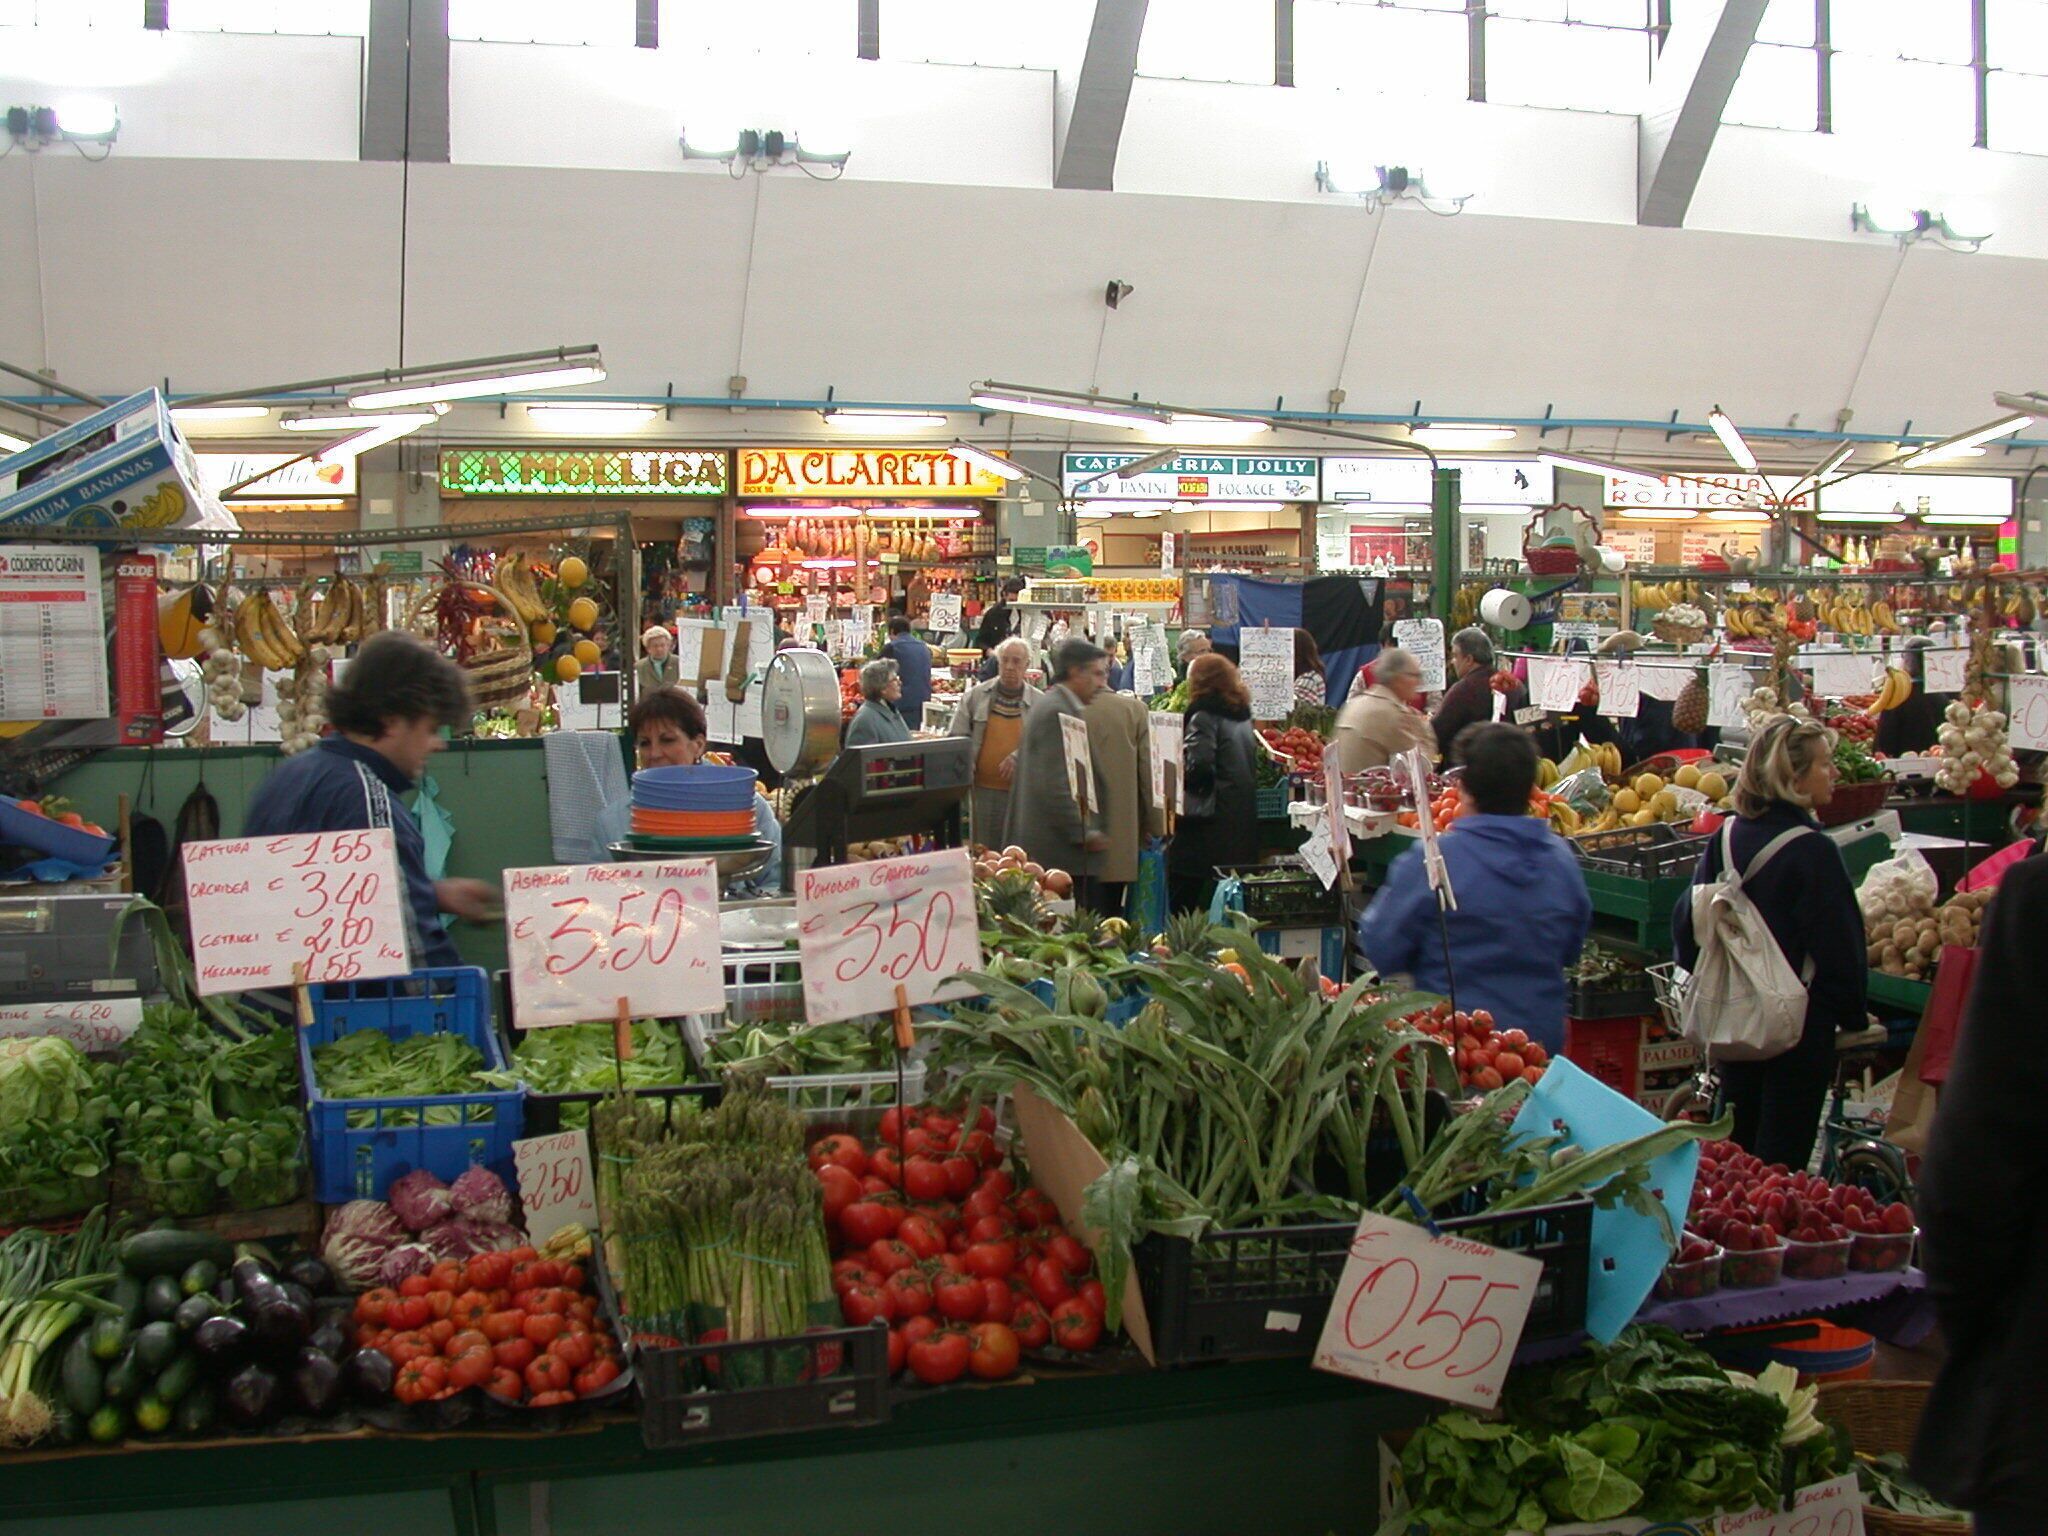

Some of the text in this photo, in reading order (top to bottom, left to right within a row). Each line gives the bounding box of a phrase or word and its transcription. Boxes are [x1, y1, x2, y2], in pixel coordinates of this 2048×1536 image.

[79, 457, 155, 501] BANANAS
[446, 455, 723, 486] LA MOLLICA
[744, 452, 974, 486] DA CLARETTI
[1245, 460, 1308, 475] JOLLY
[1120, 481, 1168, 495] PANINI
[1218, 481, 1276, 496] FOCACCE
[119, 565, 155, 577] EXIDE
[186, 842, 251, 863] LATTUGA
[292, 832, 371, 867] 1.55
[190, 871, 380, 918] ORCHIDEA € 3.40
[804, 873, 860, 901] POMODORI
[199, 917, 373, 953] CETRIOLI € 2.00
[514, 916, 535, 940] €
[545, 888, 684, 976] 3.50
[802, 914, 826, 934] €
[836, 888, 954, 982] 3.50
[519, 1134, 576, 1160] EXTRA
[522, 1157, 583, 1212] 2.50
[1350, 1231, 1390, 1262] €
[1345, 1258, 1520, 1378] 0,55
